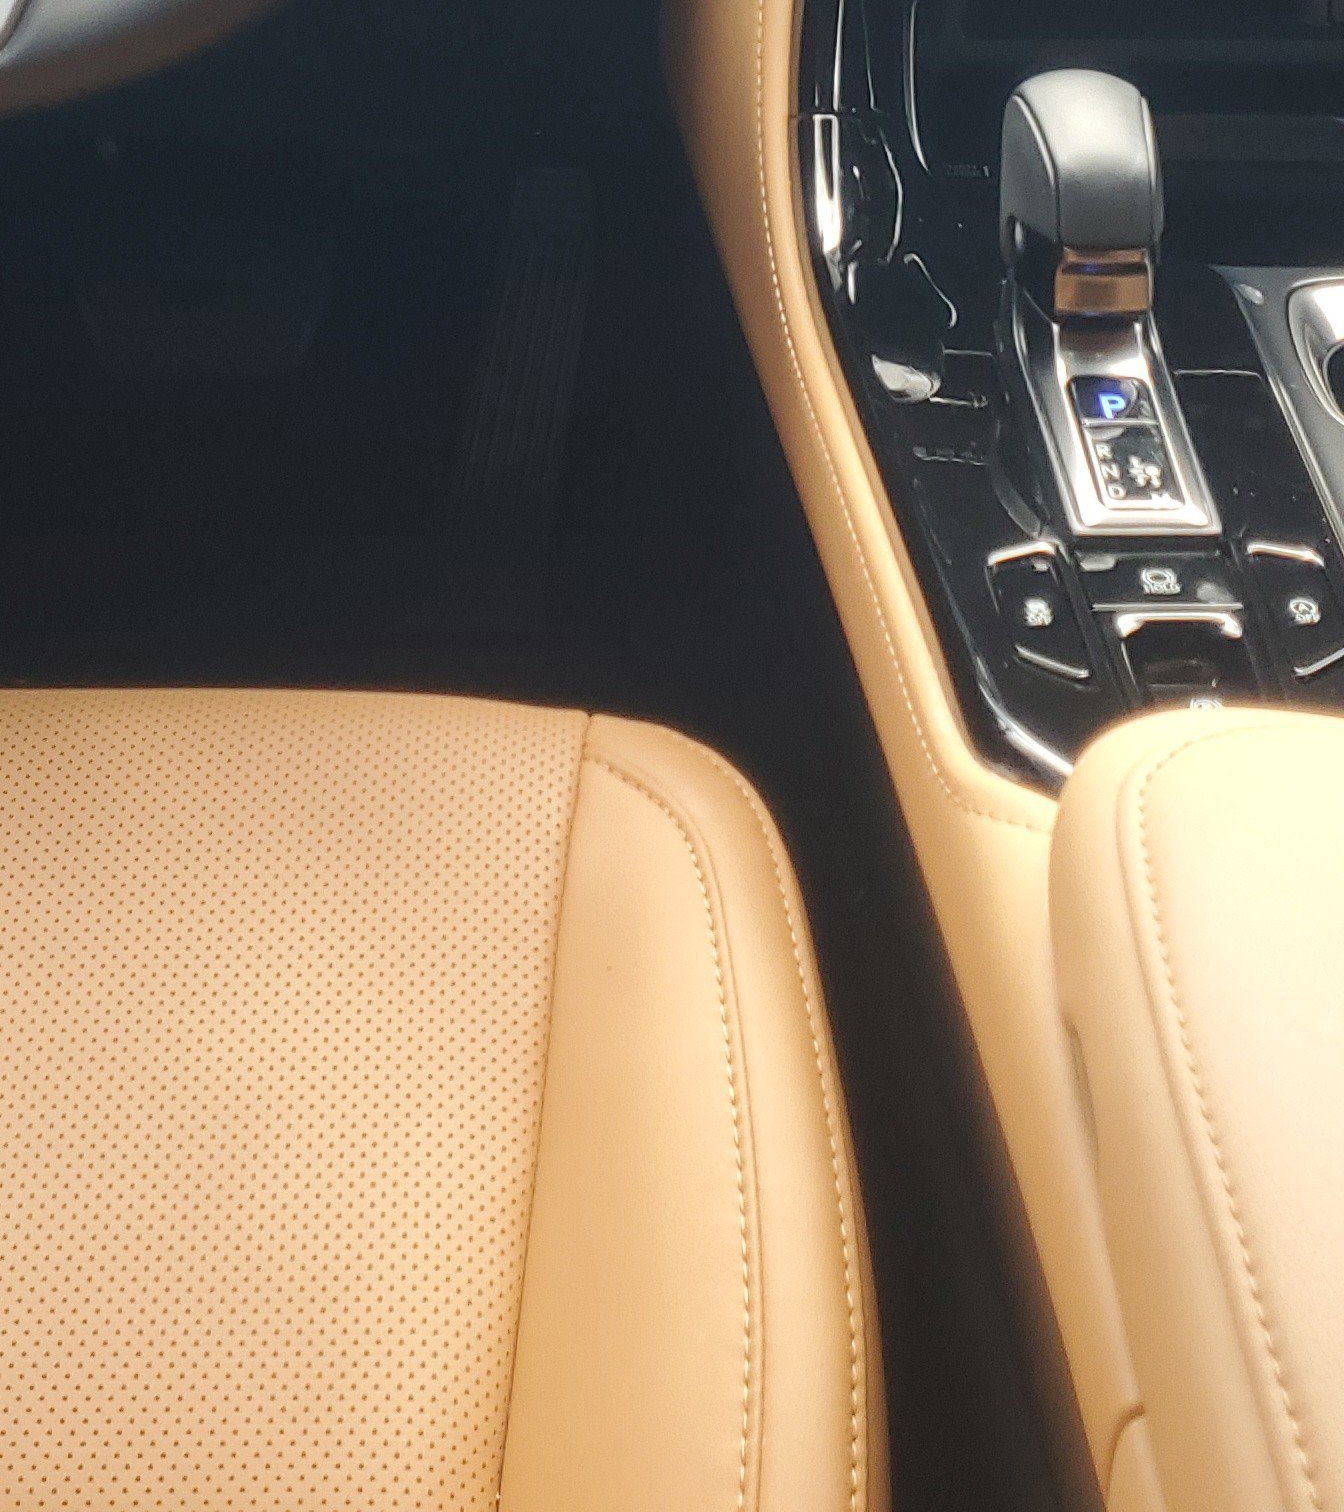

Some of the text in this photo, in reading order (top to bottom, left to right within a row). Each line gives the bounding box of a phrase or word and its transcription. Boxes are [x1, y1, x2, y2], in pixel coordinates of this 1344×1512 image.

[1098, 392, 1126, 419] P
[1096, 443, 1113, 460] R
[1101, 462, 1120, 480] N
[1108, 483, 1126, 500] D
